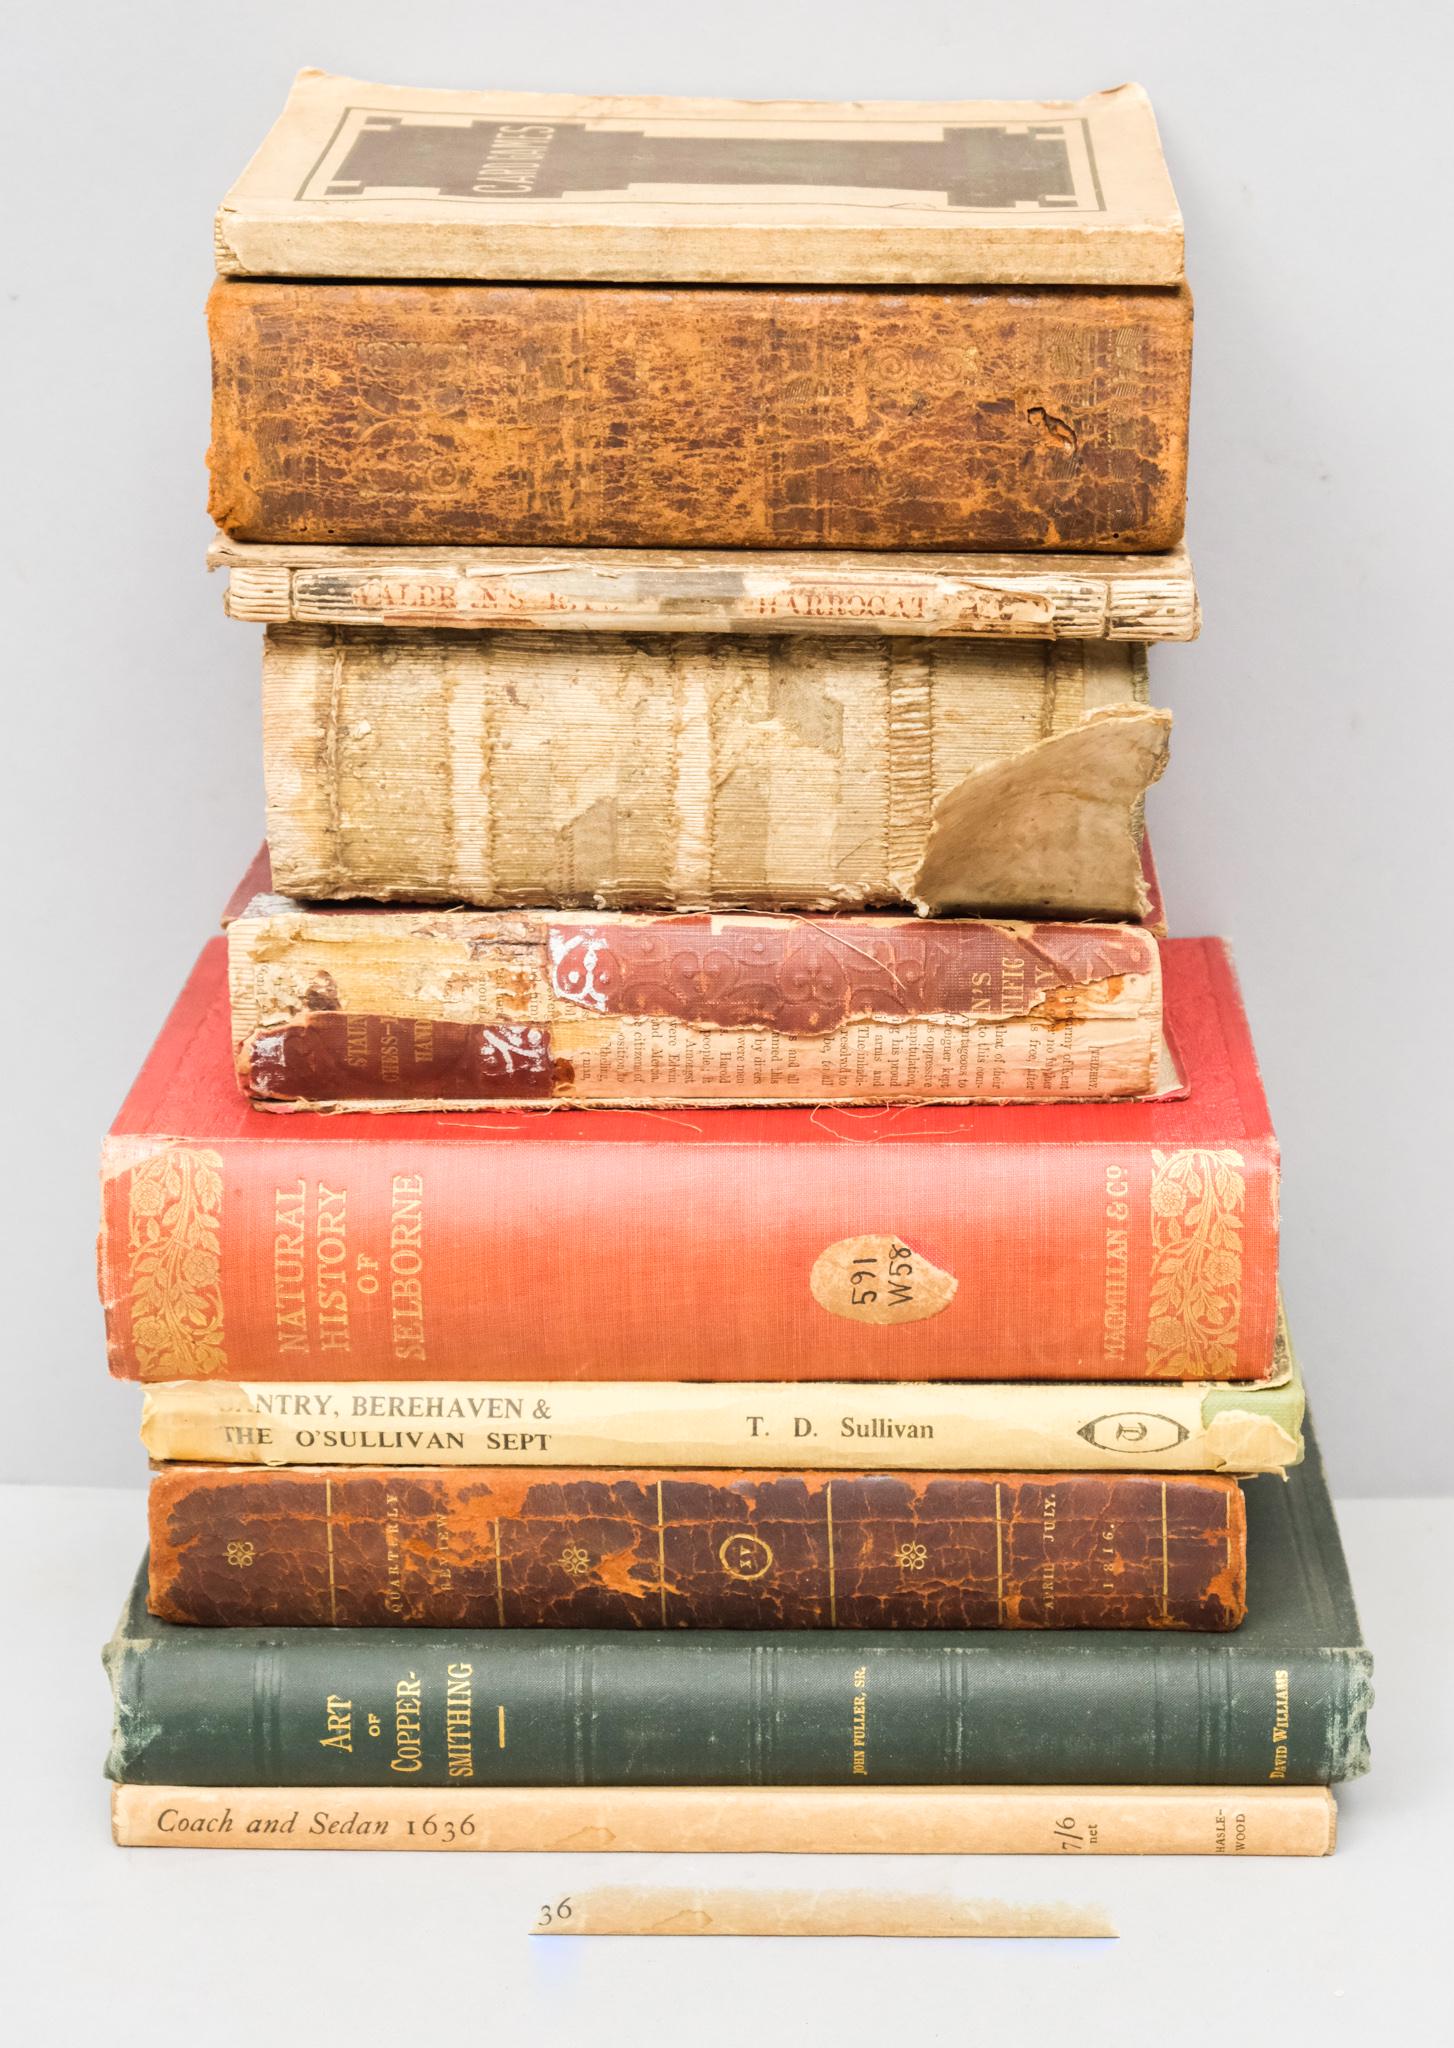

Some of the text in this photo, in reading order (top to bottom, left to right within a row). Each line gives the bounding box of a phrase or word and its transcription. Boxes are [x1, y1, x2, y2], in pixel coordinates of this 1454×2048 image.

[472, 125, 555, 193] CARD GAMES
[819, 1037, 835, 1054] be,
[857, 1026, 870, 1050] The
[874, 1034, 884, 1062] arms
[891, 1039, 903, 1056] his
[978, 1025, 988, 1038] to
[667, 1053, 680, 1083] Edwin
[682, 1038, 697, 1084] Amongst
[719, 1051, 732, 1084] Harold
[736, 1037, 745, 1084] were men
[751, 1038, 766, 1085] by divers
[788, 1049, 800, 1068] and
[922, 1036, 936, 1088] oppressive
[976, 1042, 990, 1064] this
[992, 1025, 1008, 1090] that of their
[1063, 1054, 1074, 1064] of
[633, 1074, 645, 1083] of
[838, 1077, 848, 1086] to
[872, 1070, 884, 1087] and
[887, 1059, 902, 1087] proud
[938, 1067, 953, 1088] kept
[957, 1079, 967, 1089] to
[1059, 1067, 1074, 1091] Kent
[1107, 1202, 1129, 1221] &
[275, 1179, 309, 1353] NATURAL
[317, 1182, 350, 1352] HISTORY
[357, 1253, 379, 1294] OF
[391, 1174, 426, 1361] SELBORNE
[850, 1258, 877, 1305] 591
[888, 1244, 913, 1306] W58
[1103, 1227, 1129, 1362] MACMILLAN
[218, 1394, 552, 1420] NTRY, BEREHAVEN &
[223, 1426, 551, 1452] THE O'SULLIVAN SEPT
[746, 1416, 934, 1440] T. D. Sullivan
[386, 1493, 402, 1613] QUARTERLY
[435, 1512, 453, 1592] REVIEW
[1042, 1493, 1056, 1610] APRIL JULY.
[319, 1694, 353, 1753] ART
[367, 1712, 381, 1737] OF
[390, 1671, 422, 1773] COPPER-
[446, 1662, 474, 1777] SMITHING
[852, 1666, 868, 1776] JOHN FULLER, SR.
[1268, 1669, 1289, 1779] DAVID WILLIAMS
[157, 1808, 476, 1843] Coach and Sedan 1636
[1053, 1816, 1084, 1851] 7/6
[1087, 1823, 1099, 1845] net
[1215, 1808, 1226, 1854] HASLE-
[1235, 1812, 1247, 1852] WOOD
[538, 1897, 572, 1927] 36
